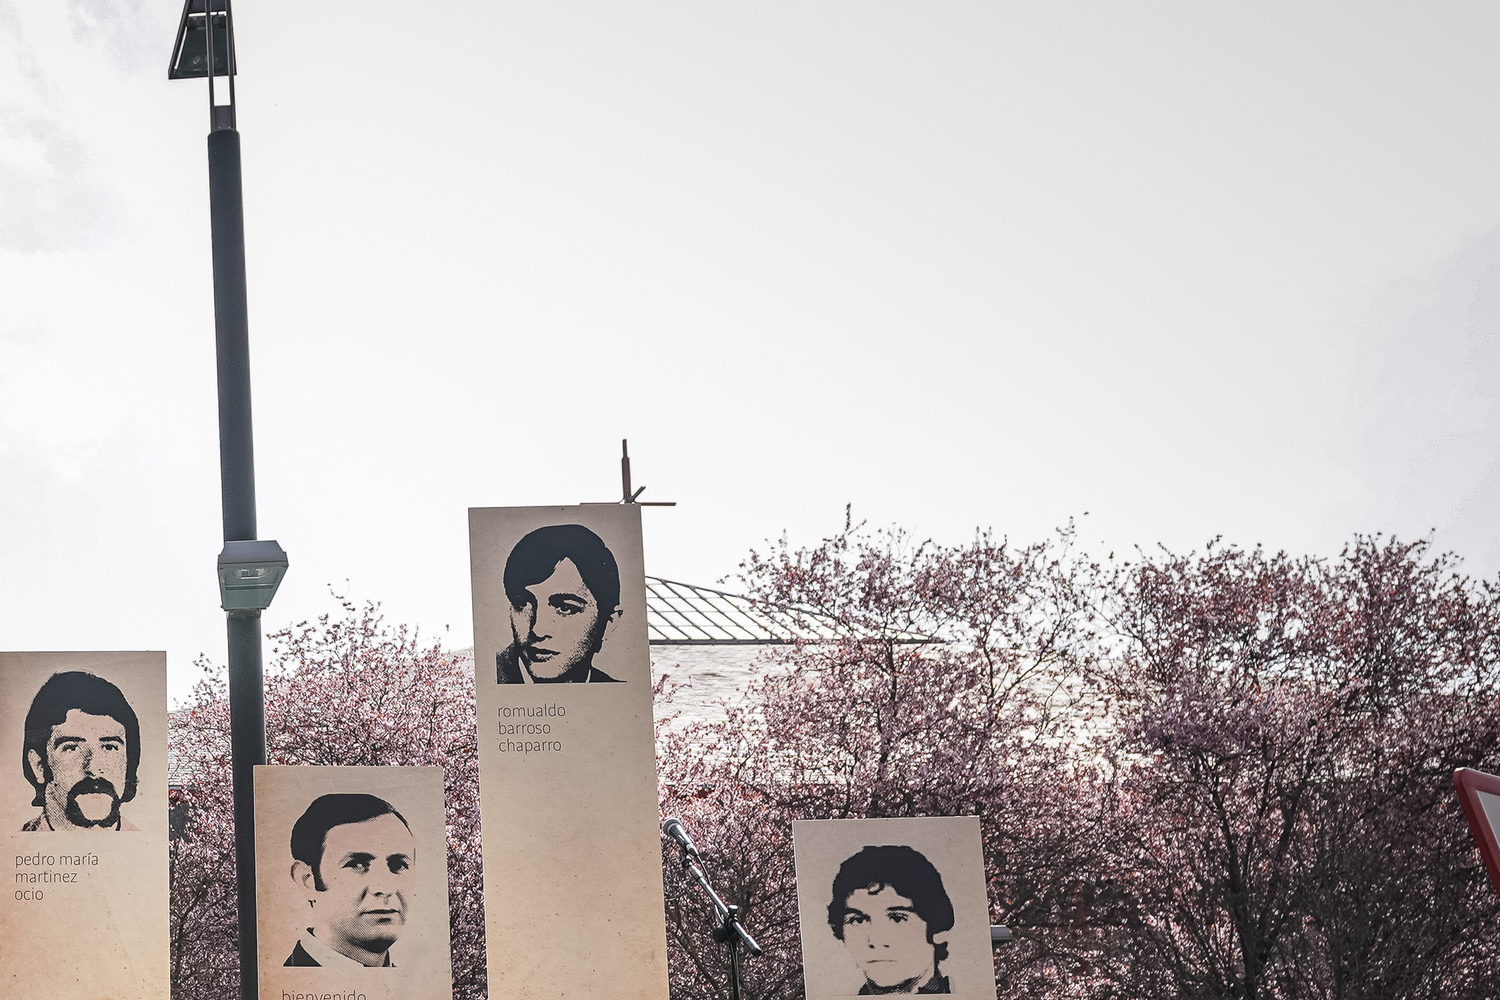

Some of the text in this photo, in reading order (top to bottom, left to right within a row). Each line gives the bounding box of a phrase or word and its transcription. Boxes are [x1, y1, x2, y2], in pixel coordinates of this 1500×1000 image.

[498, 703, 566, 718] romualdo
[499, 721, 551, 735] barroso
[499, 738, 562, 754] chaparro
[15, 852, 99, 868] pedro maría
[15, 870, 77, 883] martinez
[14, 887, 44, 901] ocio
